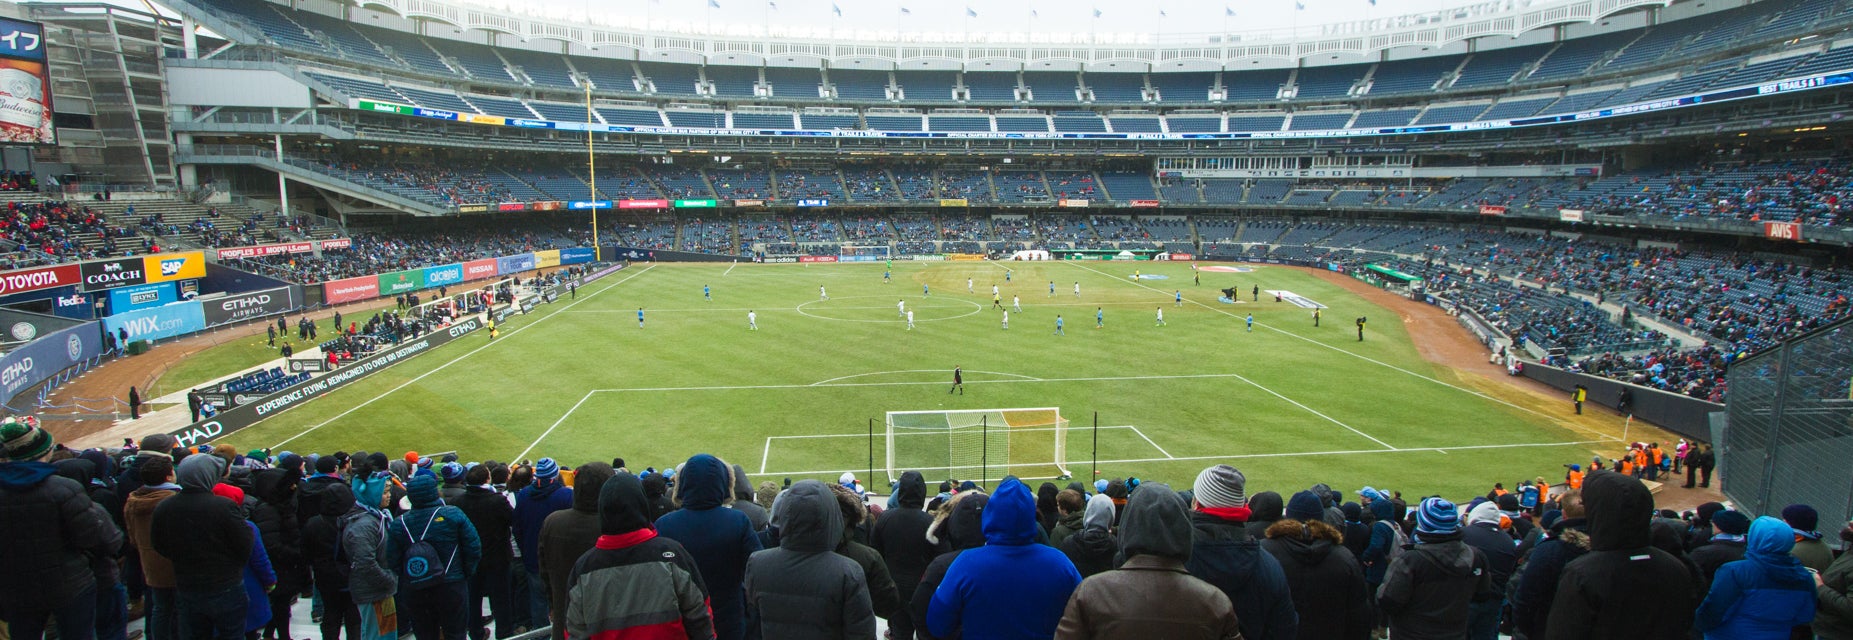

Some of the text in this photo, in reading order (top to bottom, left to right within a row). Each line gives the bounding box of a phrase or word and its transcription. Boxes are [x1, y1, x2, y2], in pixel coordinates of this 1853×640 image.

[1758, 85, 1777, 94] BEST
[1778, 79, 1807, 91] TRAILS
[1771, 223, 1792, 239] AVIS
[776, 254, 796, 263] adidas
[161, 261, 181, 274] SAP
[469, 265, 493, 273] NISSAN
[6, 271, 58, 290] TOYOTA
[87, 270, 141, 284] COACH
[58, 294, 86, 307] FedEx
[223, 295, 271, 311] ETIHAD
[232, 307, 263, 318] AIRWAYS
[449, 321, 476, 337] ETIHAD
[1, 357, 33, 385] ETIHAD
[256, 340, 429, 416] EXPERIENCE FLYING REIMAGINED TO OVER 100 DESTINATIONS
